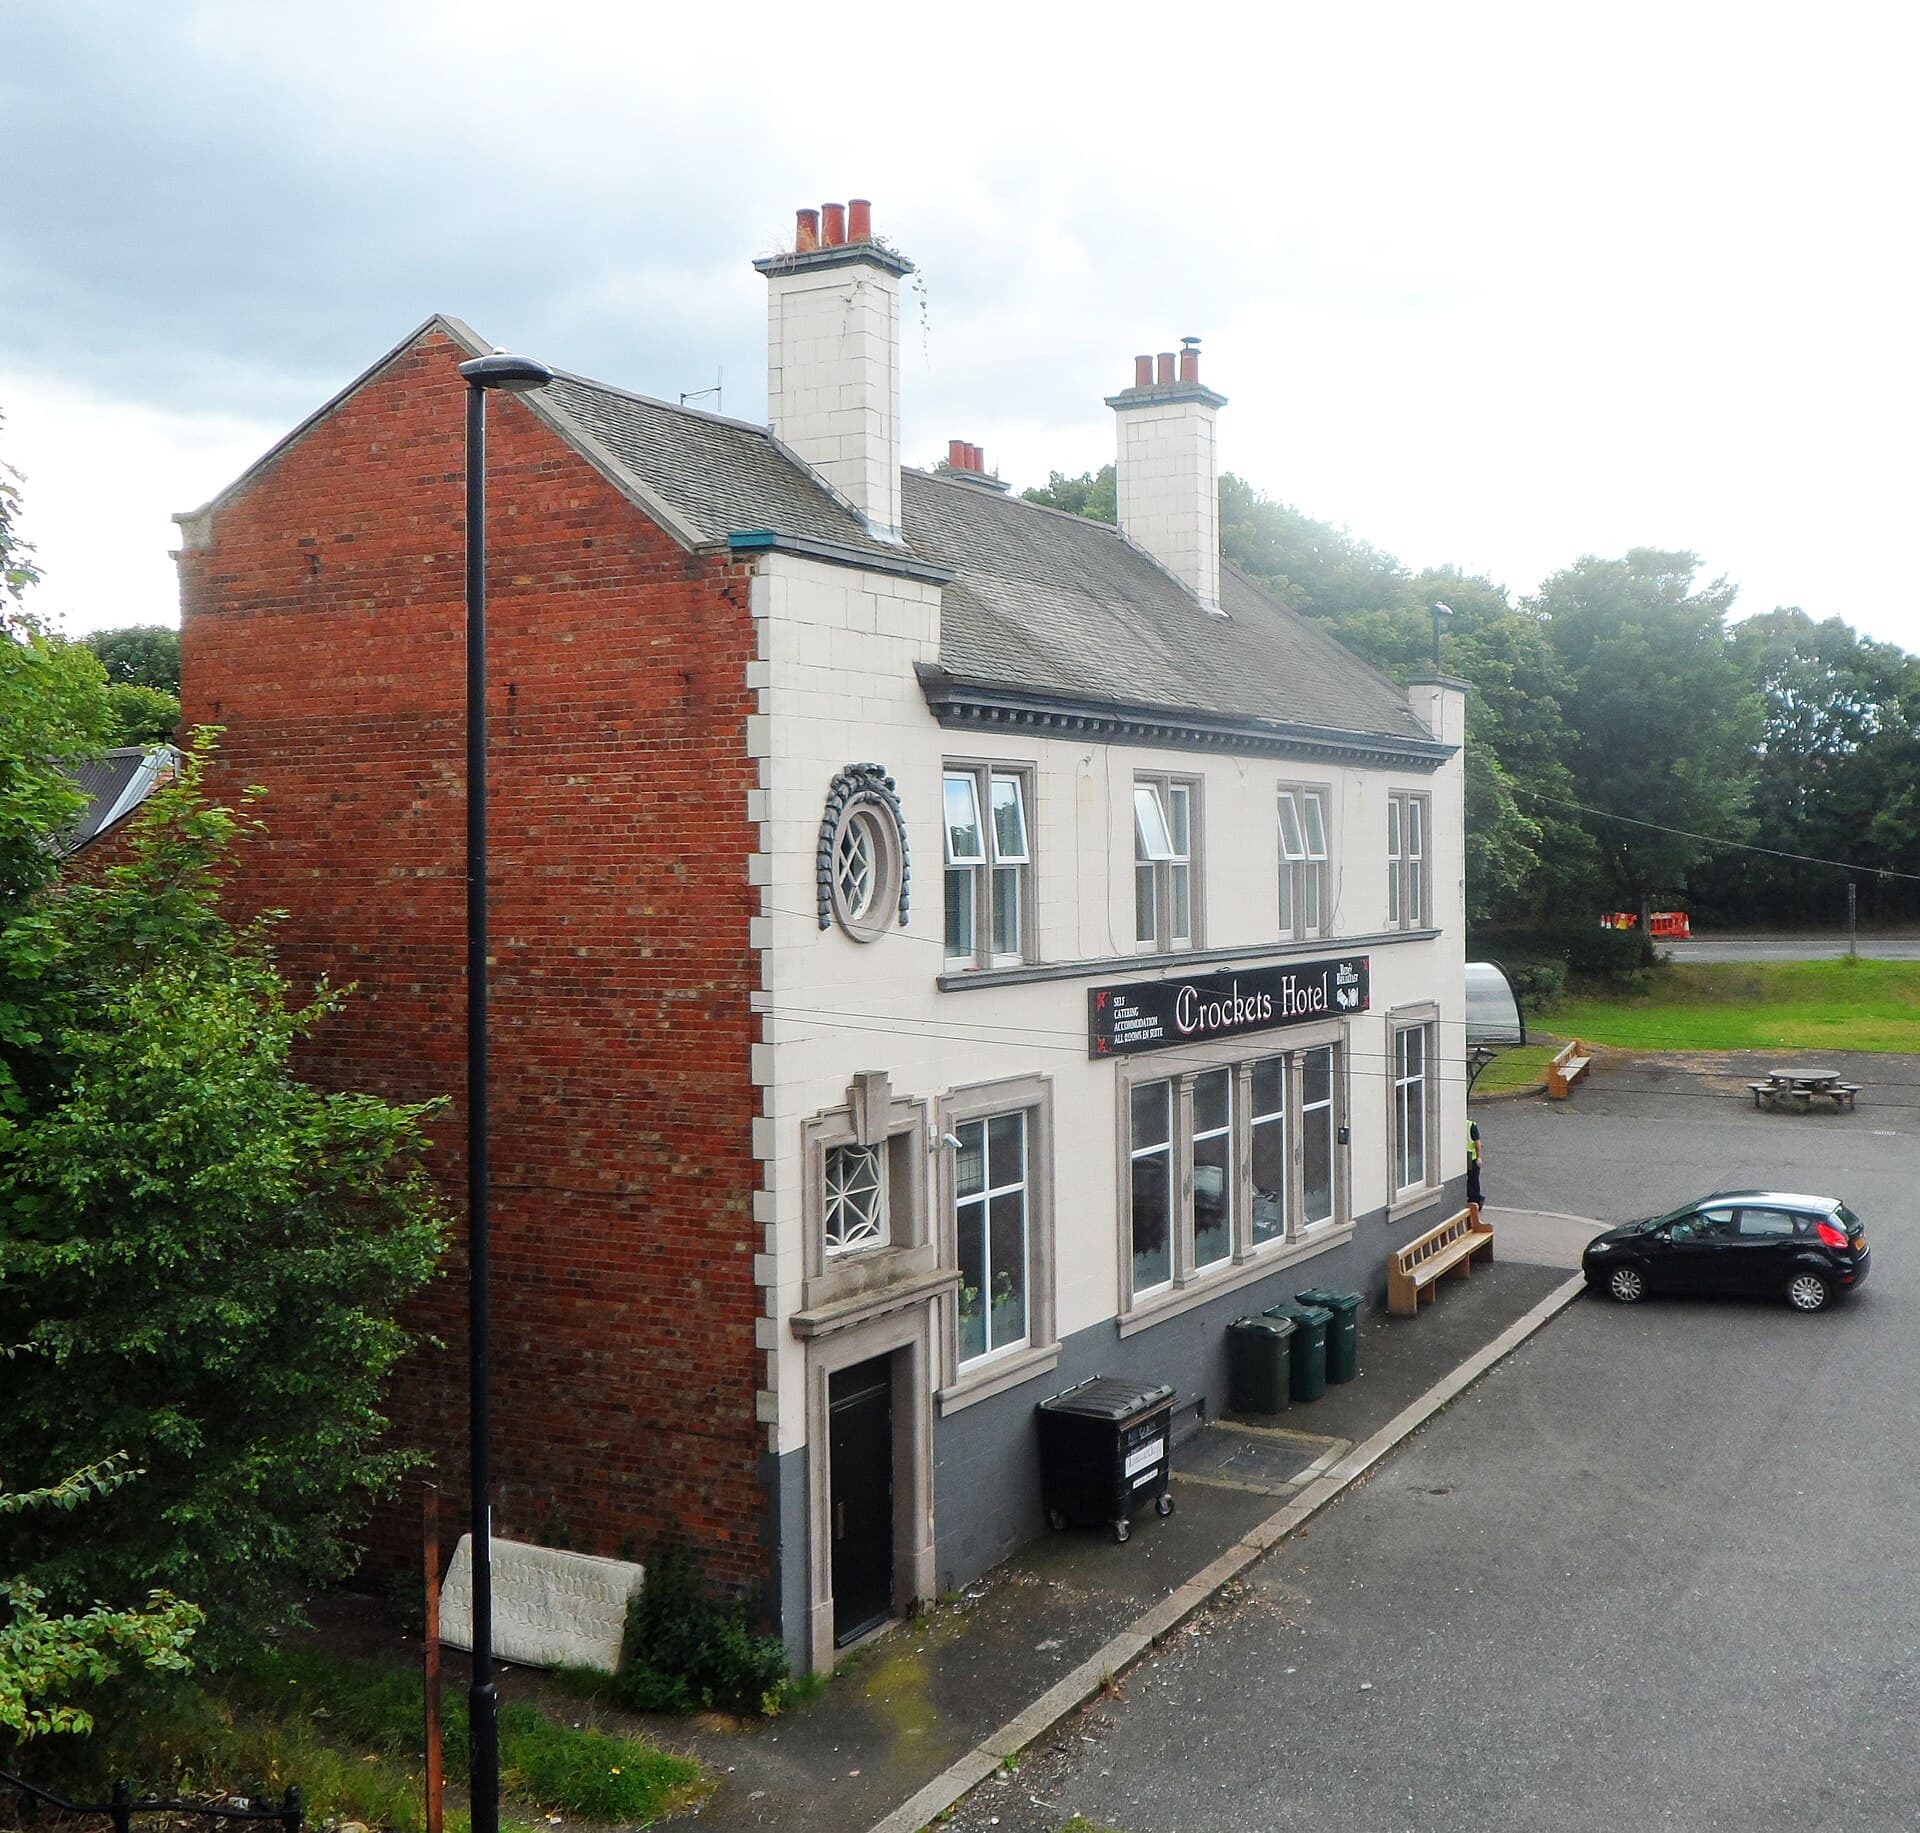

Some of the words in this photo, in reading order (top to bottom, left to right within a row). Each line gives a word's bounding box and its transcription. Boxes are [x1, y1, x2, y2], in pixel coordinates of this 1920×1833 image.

[1113, 996, 1125, 1007] SELF
[1176, 979, 1272, 1034] Crockets
[1281, 971, 1328, 1016] Hotel
[1113, 1006, 1139, 1019] CATERING
[1113, 1016, 1158, 1032] ACCOMMODATION
[1114, 1033, 1123, 1044] ALL
[1124, 1030, 1142, 1042] ROOMS
[1142, 1029, 1150, 1040] EN
[1149, 1027, 1163, 1039] SUITE
